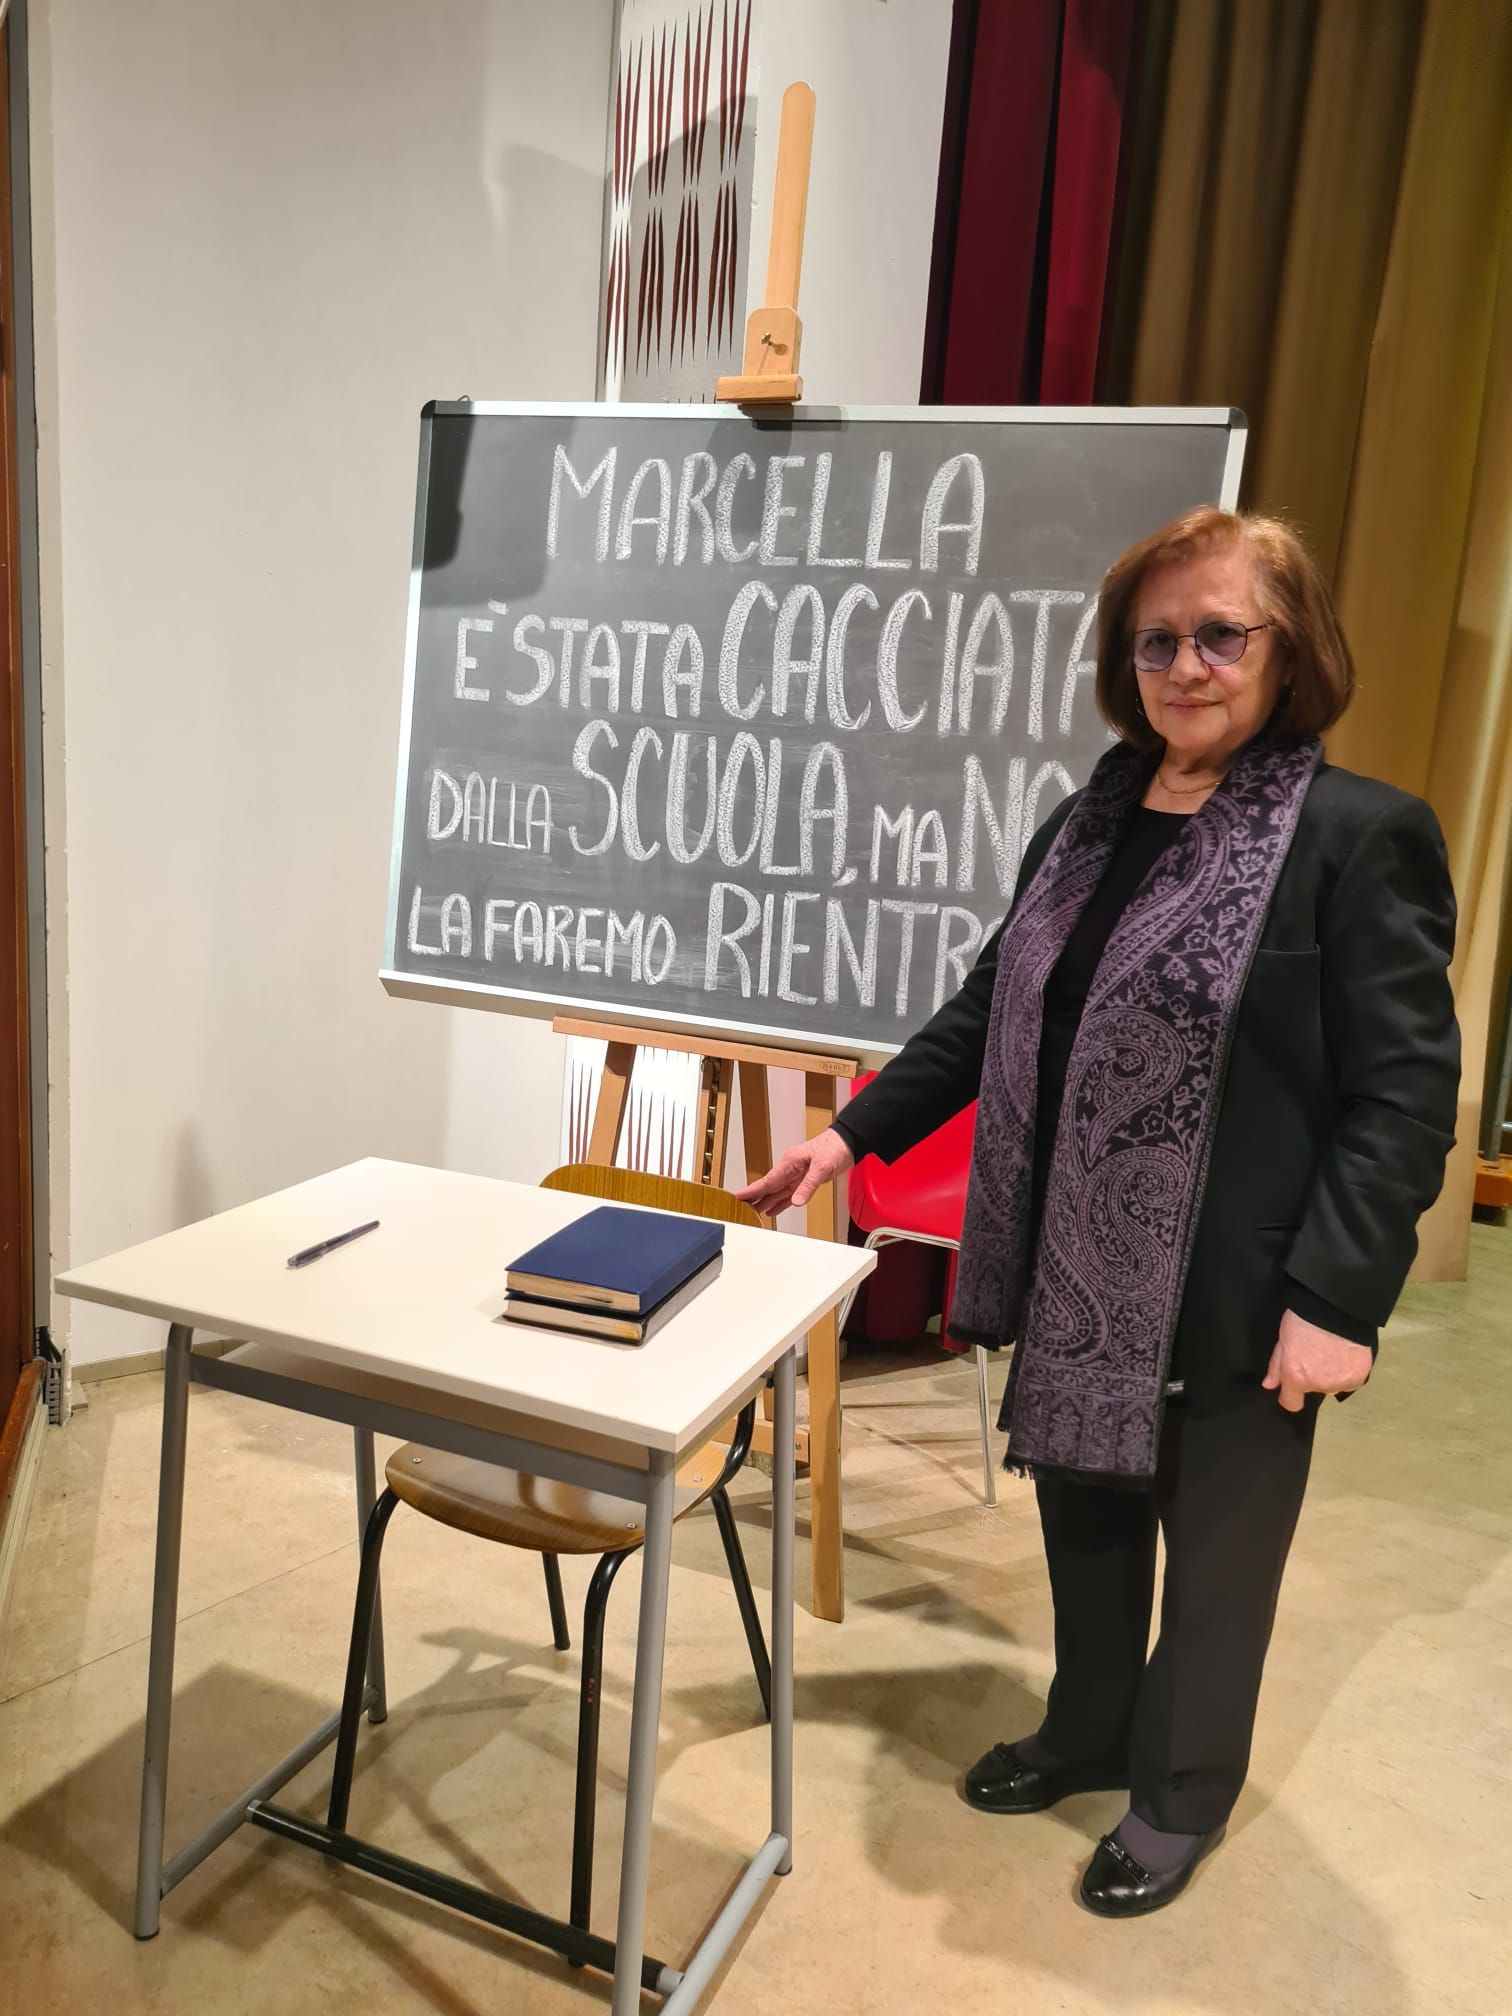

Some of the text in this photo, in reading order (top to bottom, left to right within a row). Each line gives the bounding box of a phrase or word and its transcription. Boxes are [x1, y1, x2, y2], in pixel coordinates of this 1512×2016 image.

[546, 443, 986, 578] MARCELLA
[506, 614, 705, 718] STATA
[426, 768, 554, 854] DALLA
[567, 719, 859, 887] SCUOLA,
[870, 803, 949, 889] MA
[407, 886, 472, 957] LA
[484, 900, 678, 986] FAREMO
